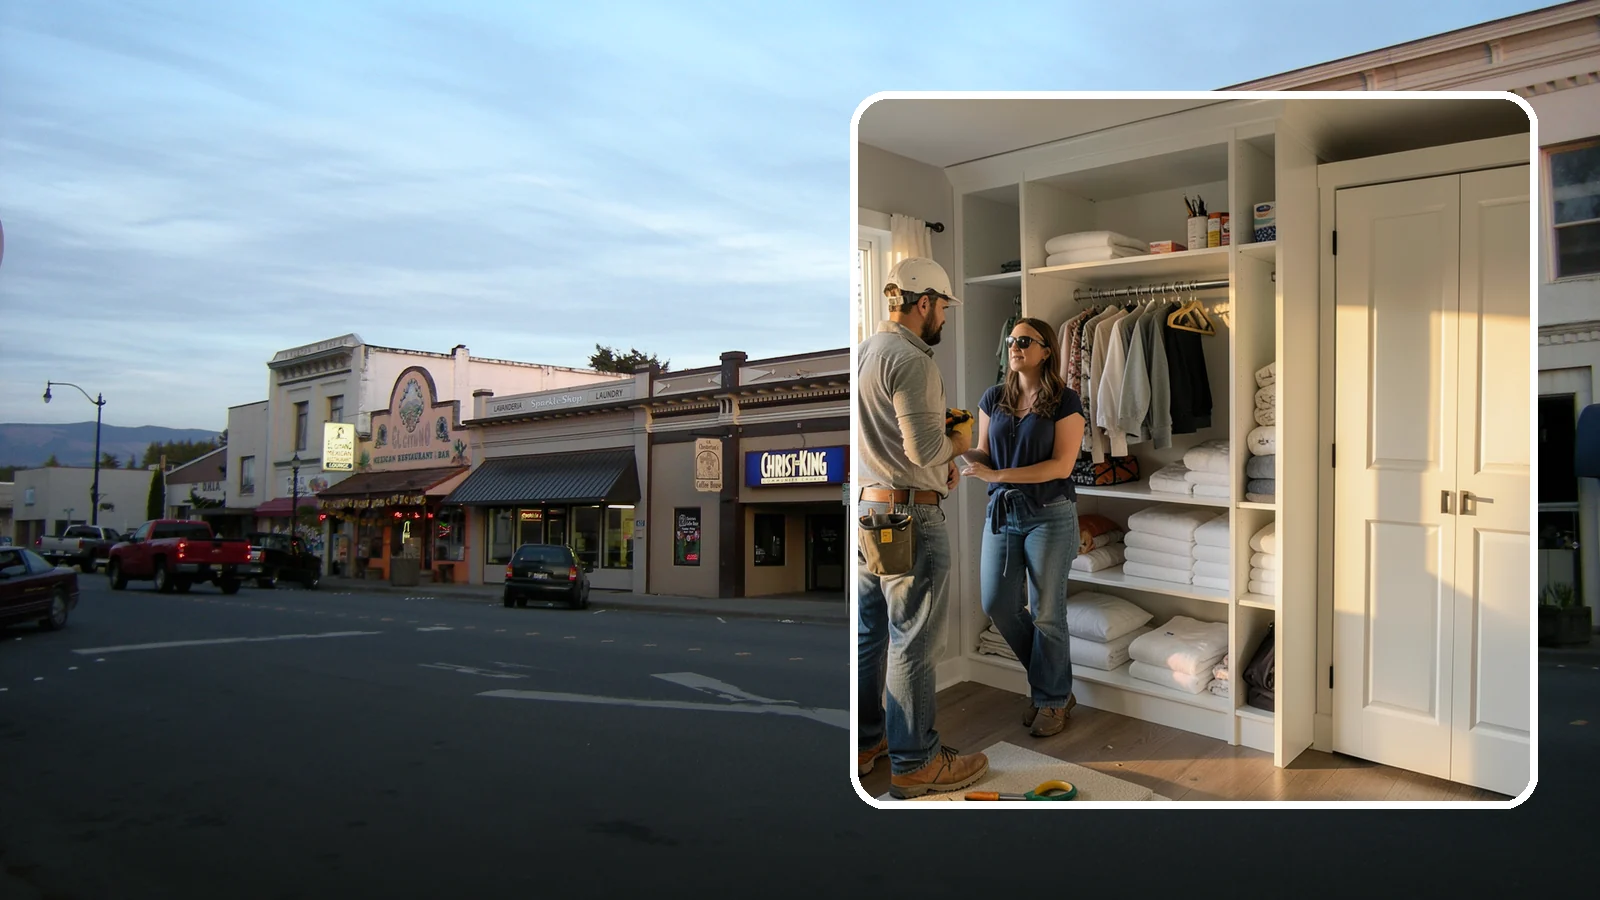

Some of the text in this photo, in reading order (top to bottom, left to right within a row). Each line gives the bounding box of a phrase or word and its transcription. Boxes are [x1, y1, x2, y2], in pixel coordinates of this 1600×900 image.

[530, 394, 583, 409] Sparkle Shop
[595, 389, 623, 400] LAUNDRY
[493, 402, 523, 413] LAVANDERIA
[374, 454, 396, 464] MEXICAN
[398, 451, 433, 463] RESTAURANT
[438, 450, 450, 460] BAR
[761, 450, 828, 478] CHRIST KING
